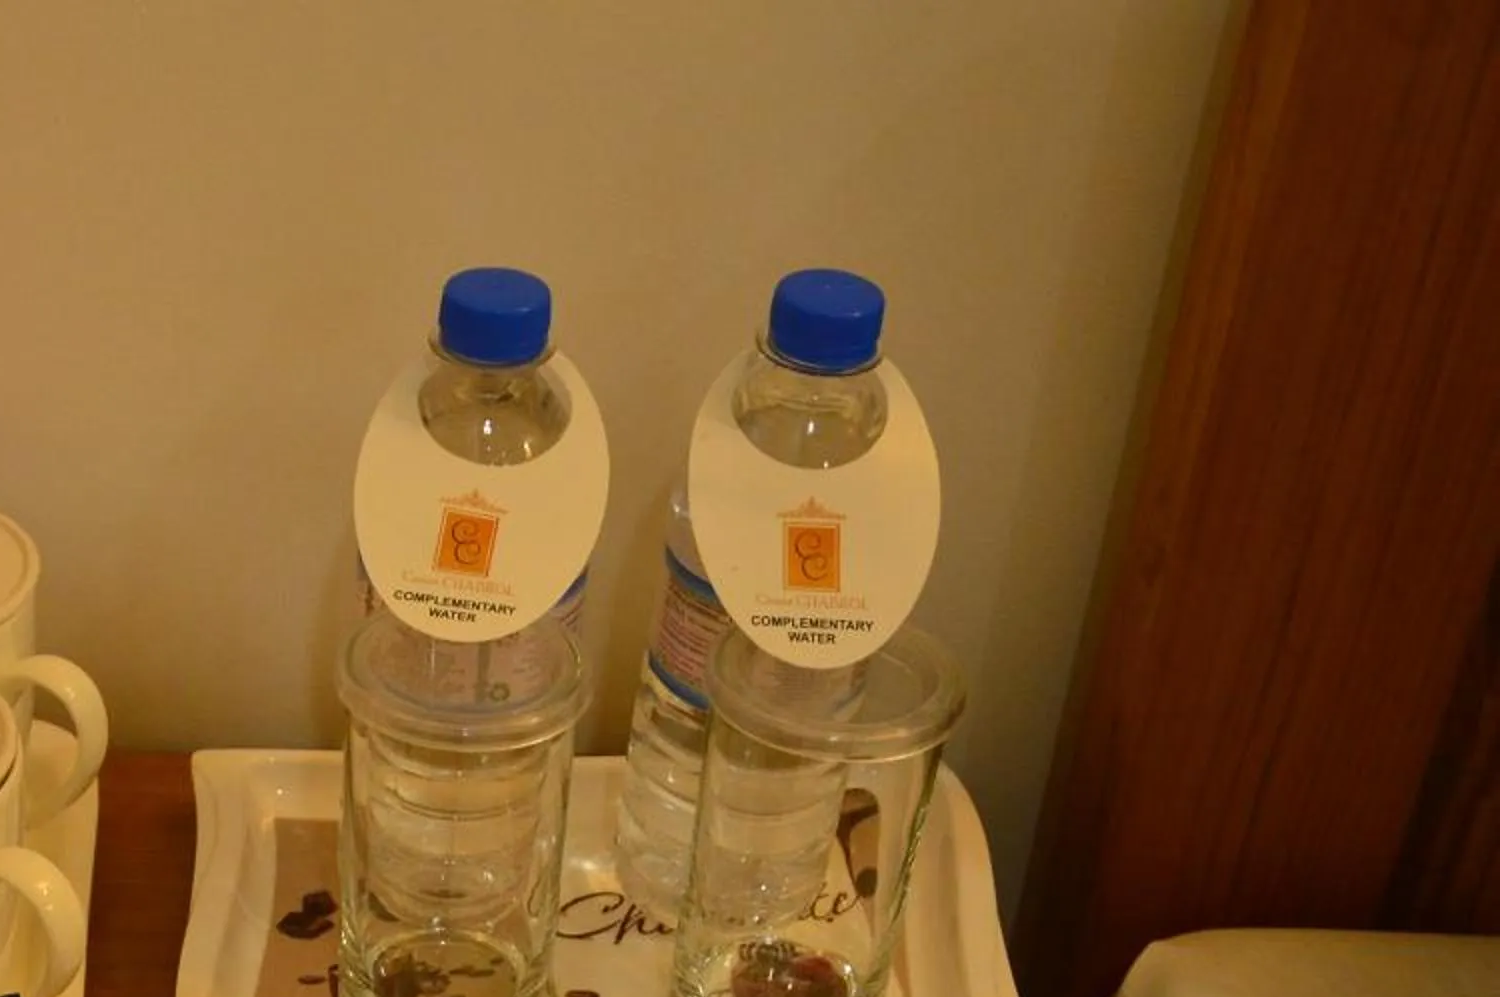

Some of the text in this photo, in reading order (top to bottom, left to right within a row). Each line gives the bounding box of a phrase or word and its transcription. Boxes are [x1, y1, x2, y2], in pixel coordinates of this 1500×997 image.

[393, 589, 516, 616] COMPLEMENTARY
[429, 607, 477, 622] WATER
[751, 615, 874, 632] COMPLEMENTARY
[788, 631, 836, 645] WATER
